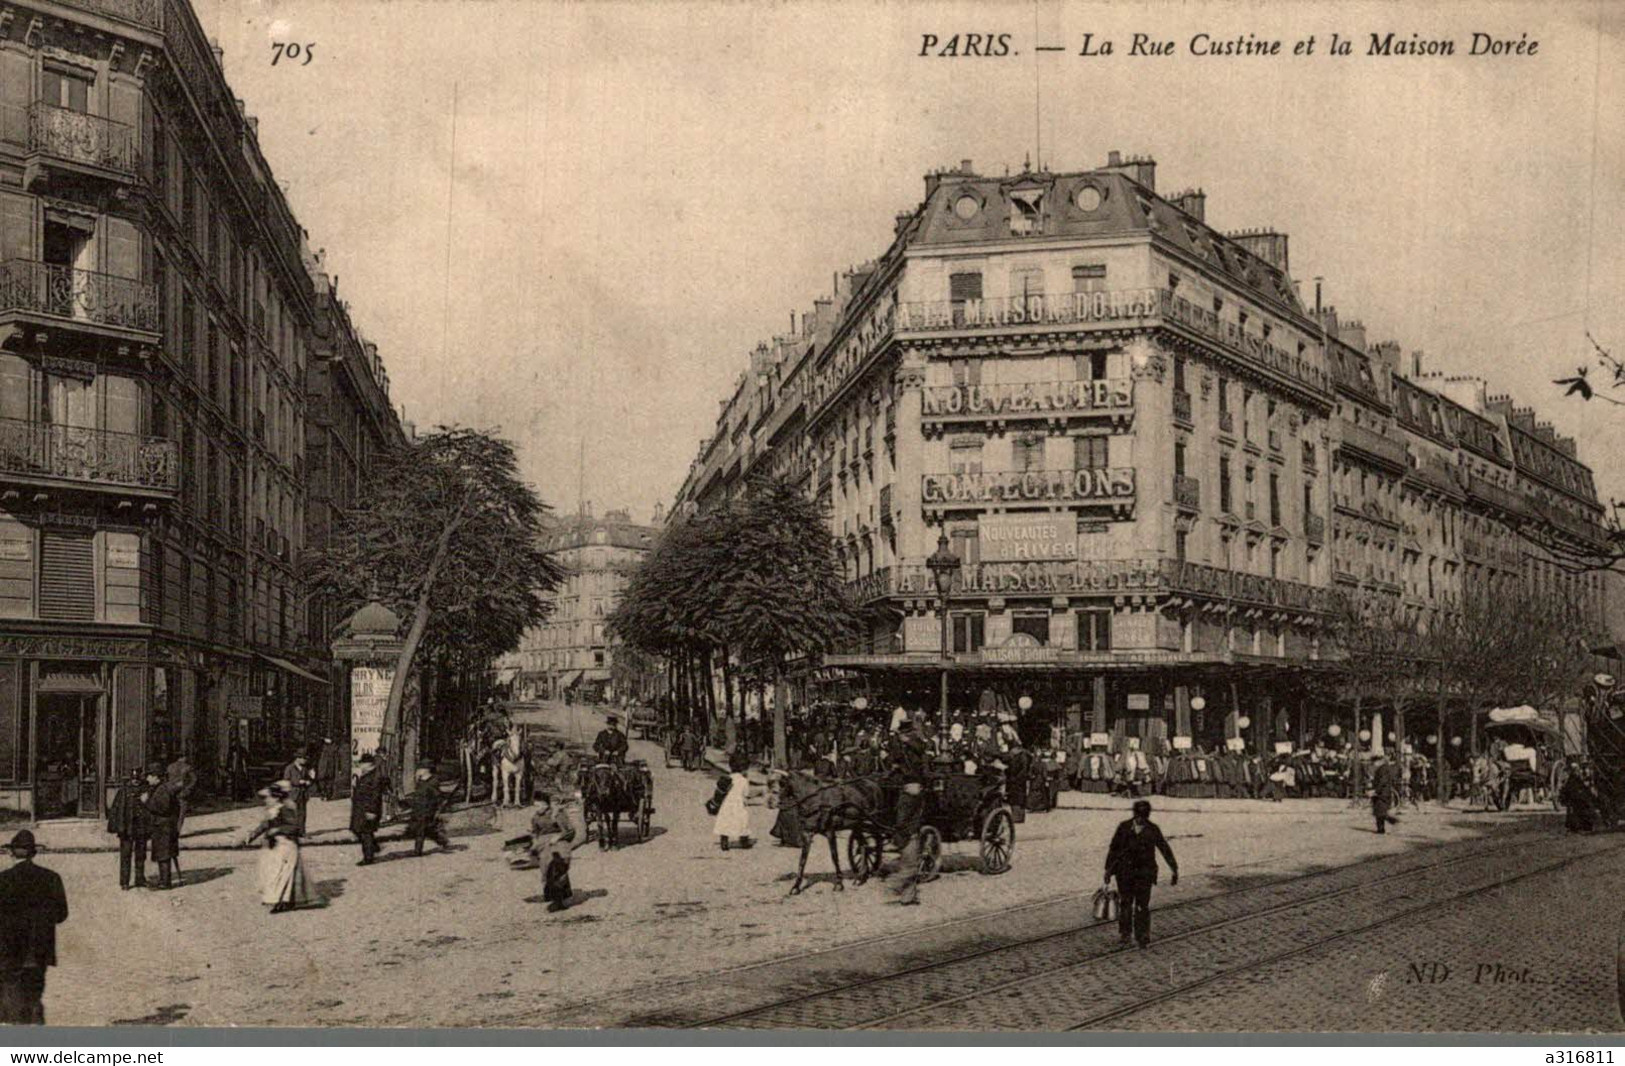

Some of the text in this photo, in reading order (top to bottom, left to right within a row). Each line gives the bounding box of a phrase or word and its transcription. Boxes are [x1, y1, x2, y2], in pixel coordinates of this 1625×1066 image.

[964, 296, 1063, 327] MAISON
[922, 379, 1132, 414] NOUVEAUTES
[922, 468, 1135, 502] CONFECTIONS
[961, 562, 1058, 592] MAISON
